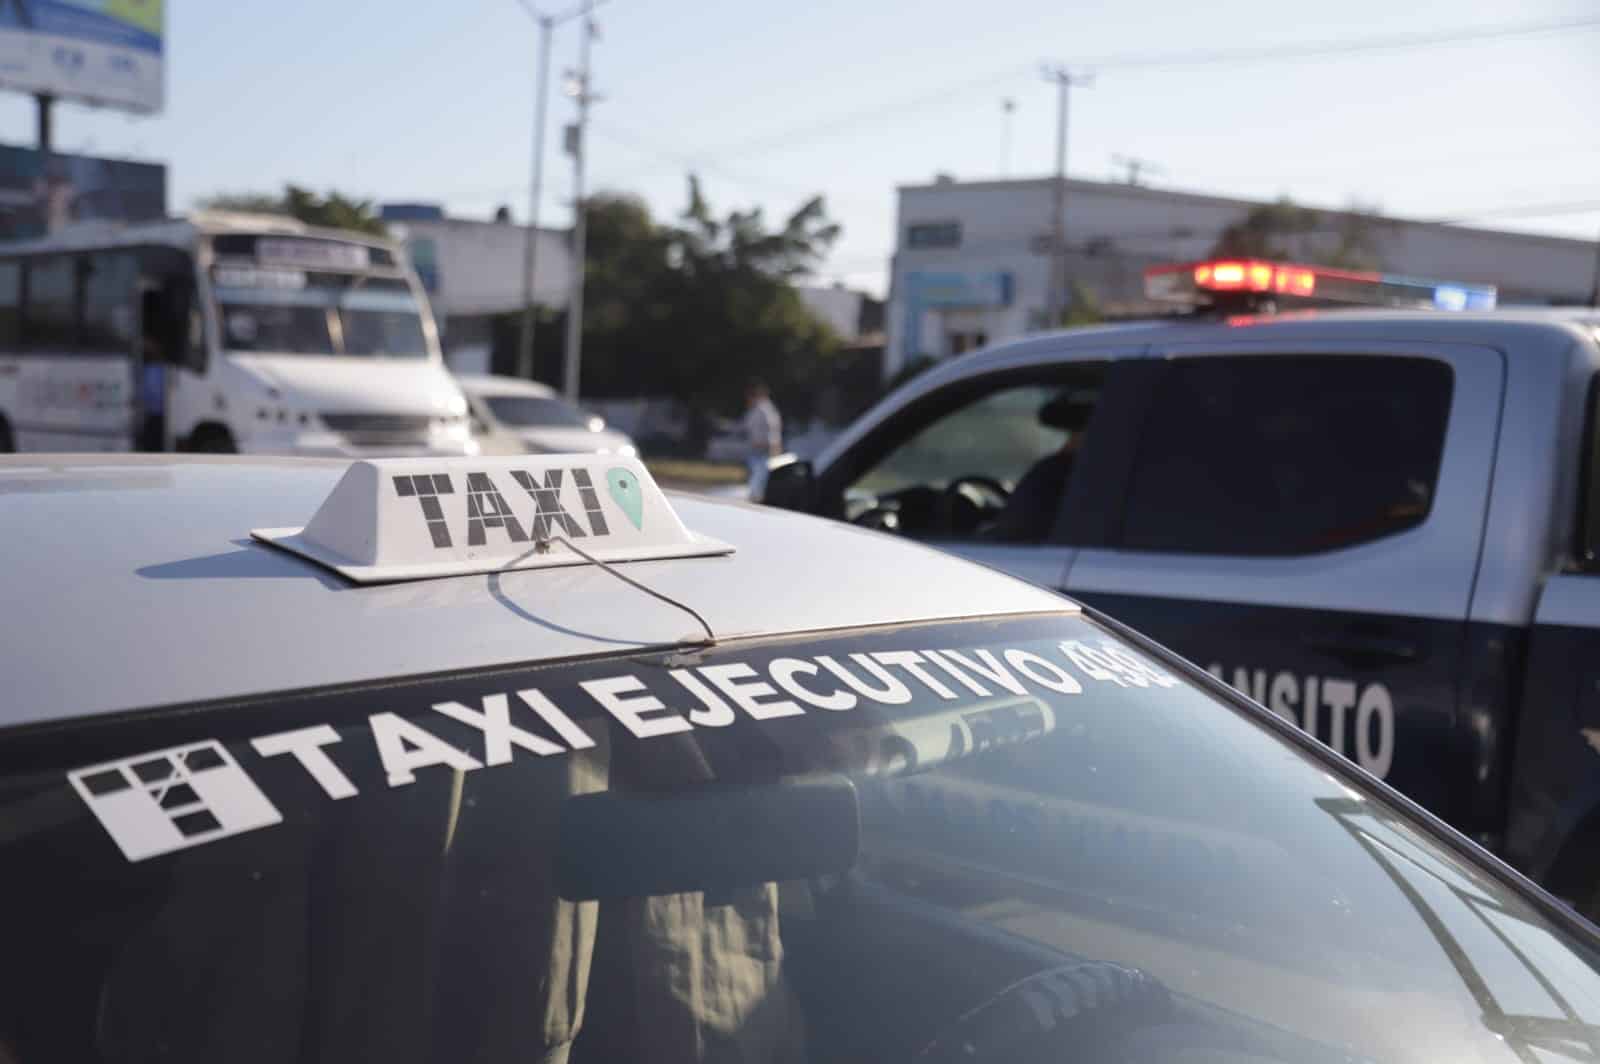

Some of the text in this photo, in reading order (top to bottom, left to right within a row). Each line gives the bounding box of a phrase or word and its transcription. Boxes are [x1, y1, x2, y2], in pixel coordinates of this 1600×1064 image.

[392, 468, 610, 548] TAXI
[250, 688, 596, 800] TAXI
[578, 648, 1083, 738] EJECUTIVO
